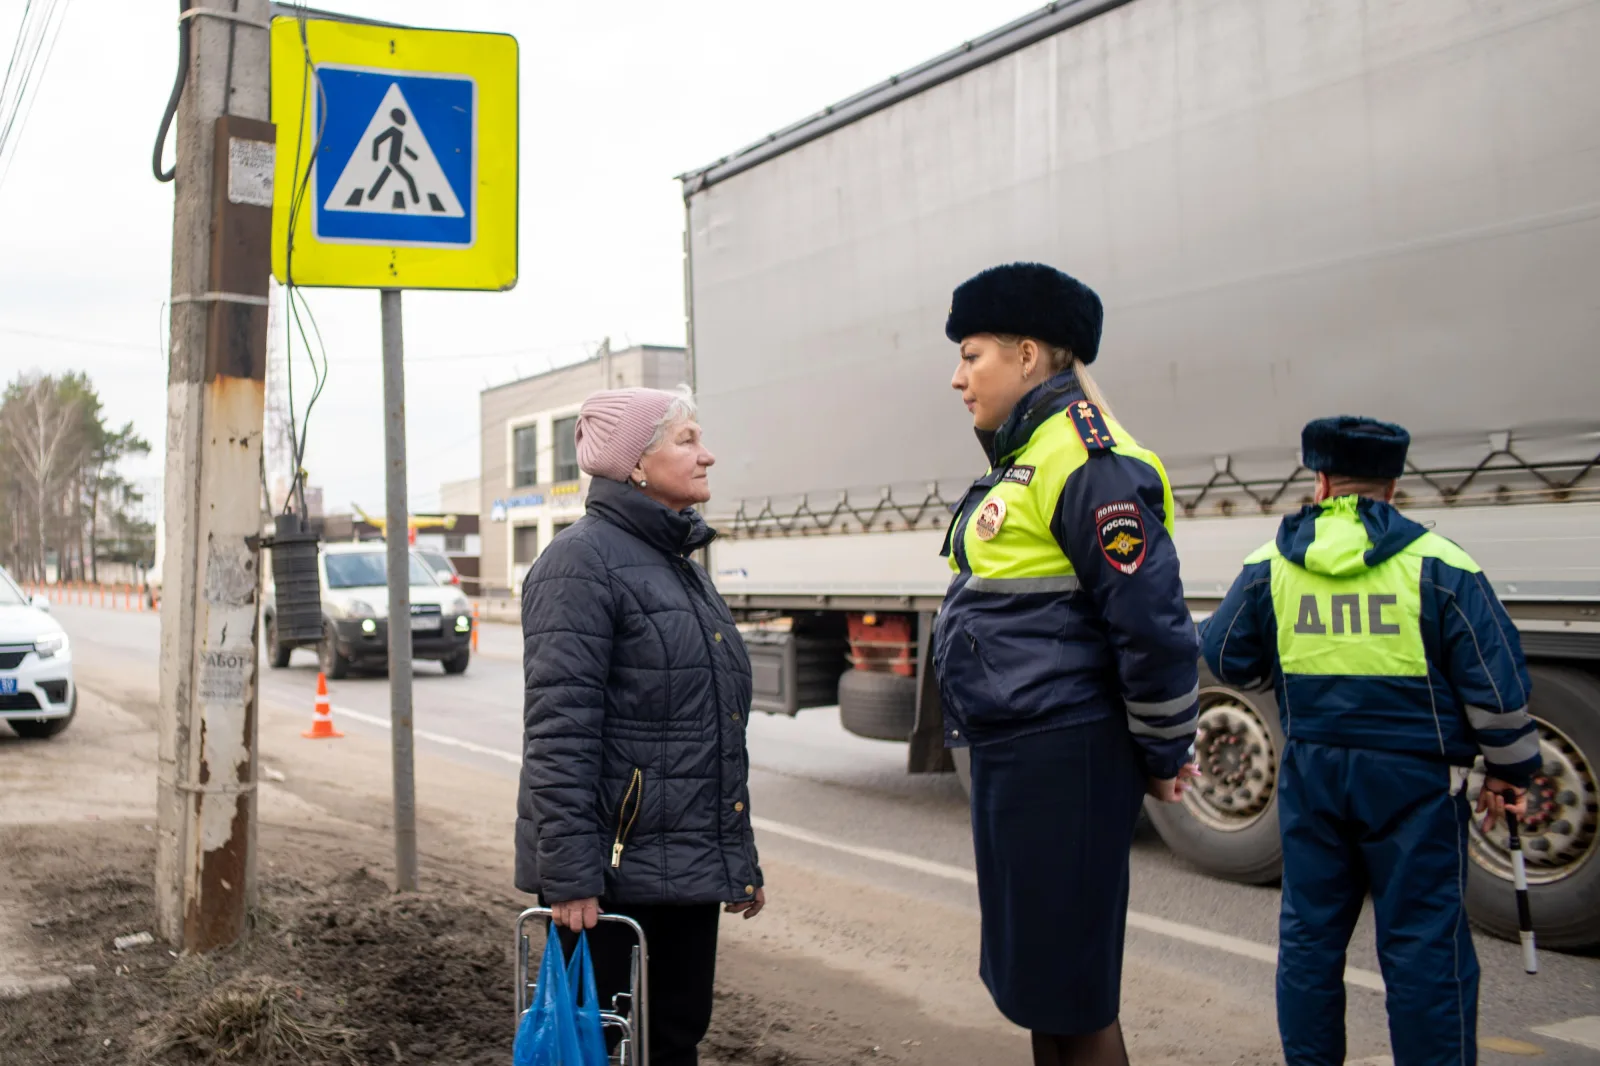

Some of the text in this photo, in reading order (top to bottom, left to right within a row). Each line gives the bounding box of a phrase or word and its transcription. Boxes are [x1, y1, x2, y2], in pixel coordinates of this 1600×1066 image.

[1097, 502, 1135, 520] ПОЛИЦИЯ
[1102, 517, 1139, 537] РОССИЯ
[1120, 560, 1138, 575] МВД
[1293, 593, 1401, 635] ДПС
